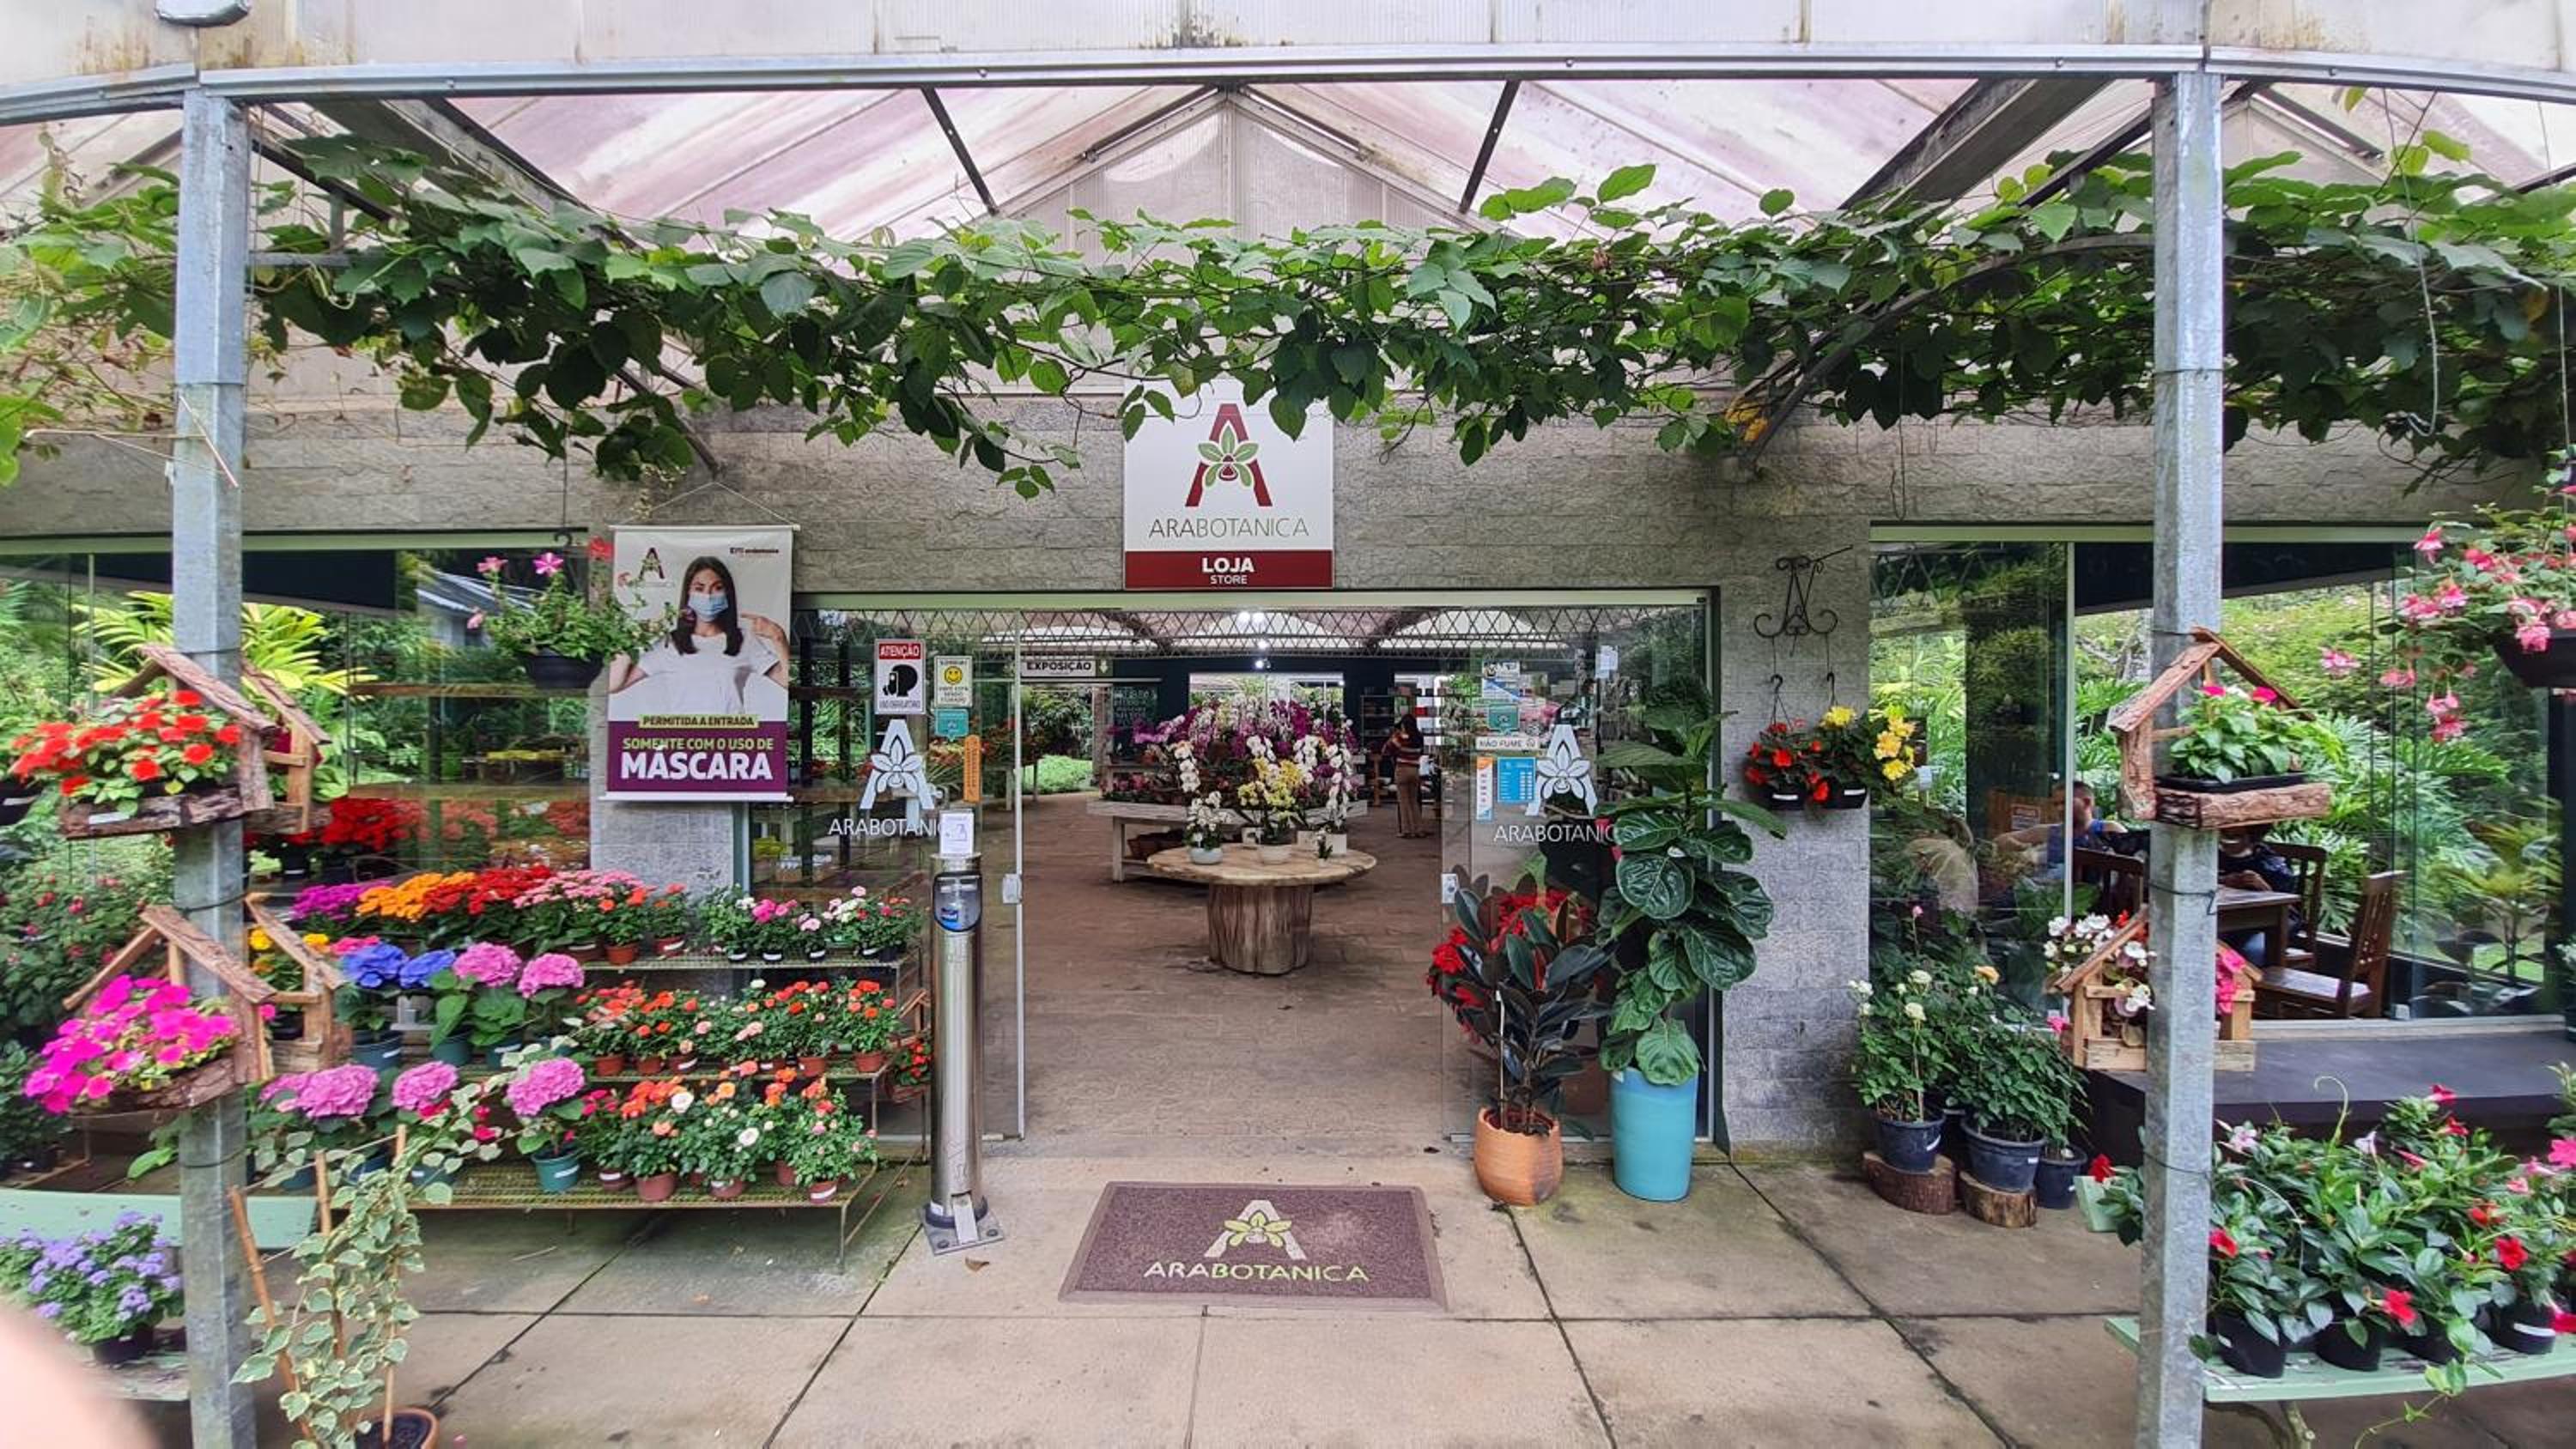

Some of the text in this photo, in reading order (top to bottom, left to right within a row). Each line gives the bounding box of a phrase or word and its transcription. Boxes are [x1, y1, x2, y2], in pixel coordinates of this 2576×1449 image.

[1149, 518, 1310, 538] ARABOTANICA
[1202, 558, 1255, 573] LOJA
[1210, 574, 1248, 585] STORE
[880, 645, 920, 659] ATENÇÃO
[644, 716, 754, 726] PERMITIDA A ENTRADA
[623, 737, 774, 749] SOMENTE COM O USO DE
[621, 745, 772, 779] MÁSCARA
[828, 818, 942, 836] ARABOTANI
[1493, 824, 1615, 842] ARABOTANIC
[1143, 1261, 1370, 1282] ARABOTANICA
